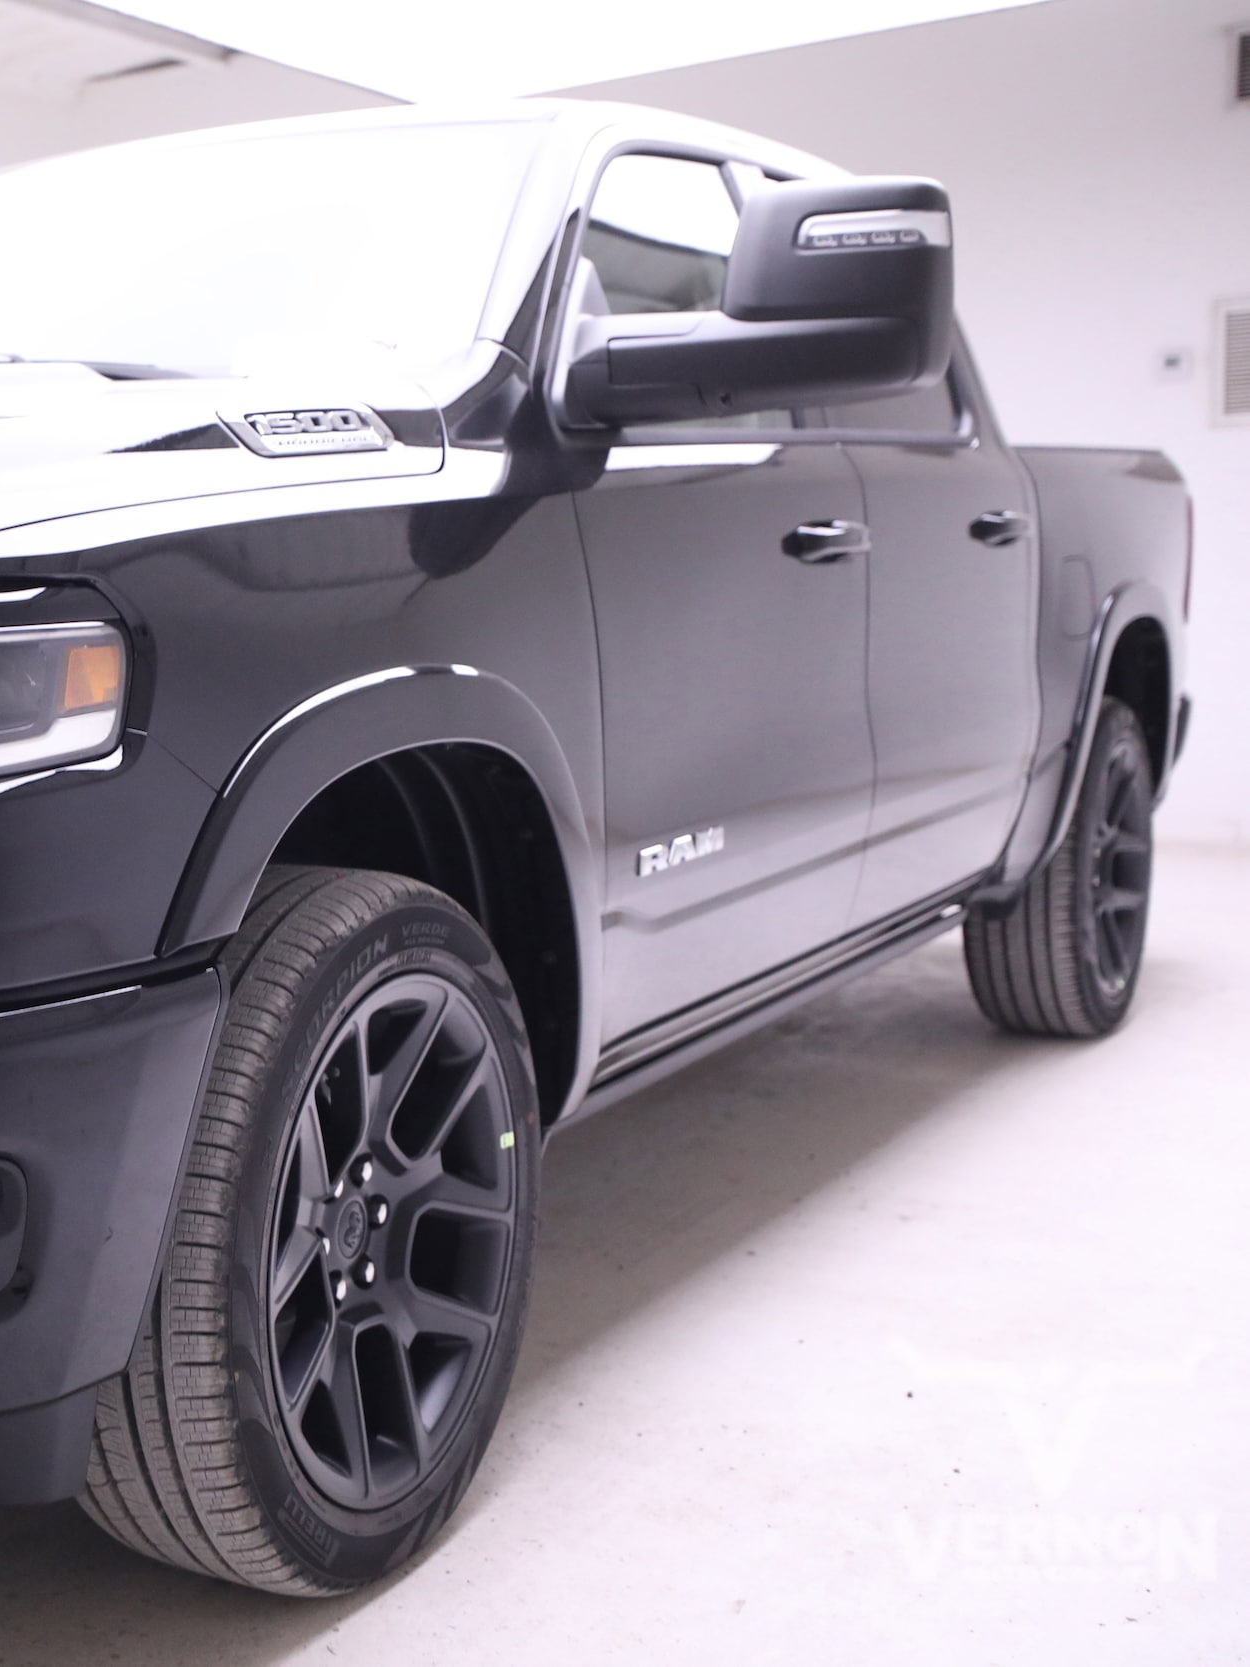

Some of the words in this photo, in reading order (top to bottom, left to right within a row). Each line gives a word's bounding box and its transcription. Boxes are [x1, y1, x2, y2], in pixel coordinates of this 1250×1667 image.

[246, 410, 363, 436] 1500
[636, 825, 724, 877] RAM
[402, 921, 450, 939] VERDE
[278, 1491, 340, 1568] PIRELLI
